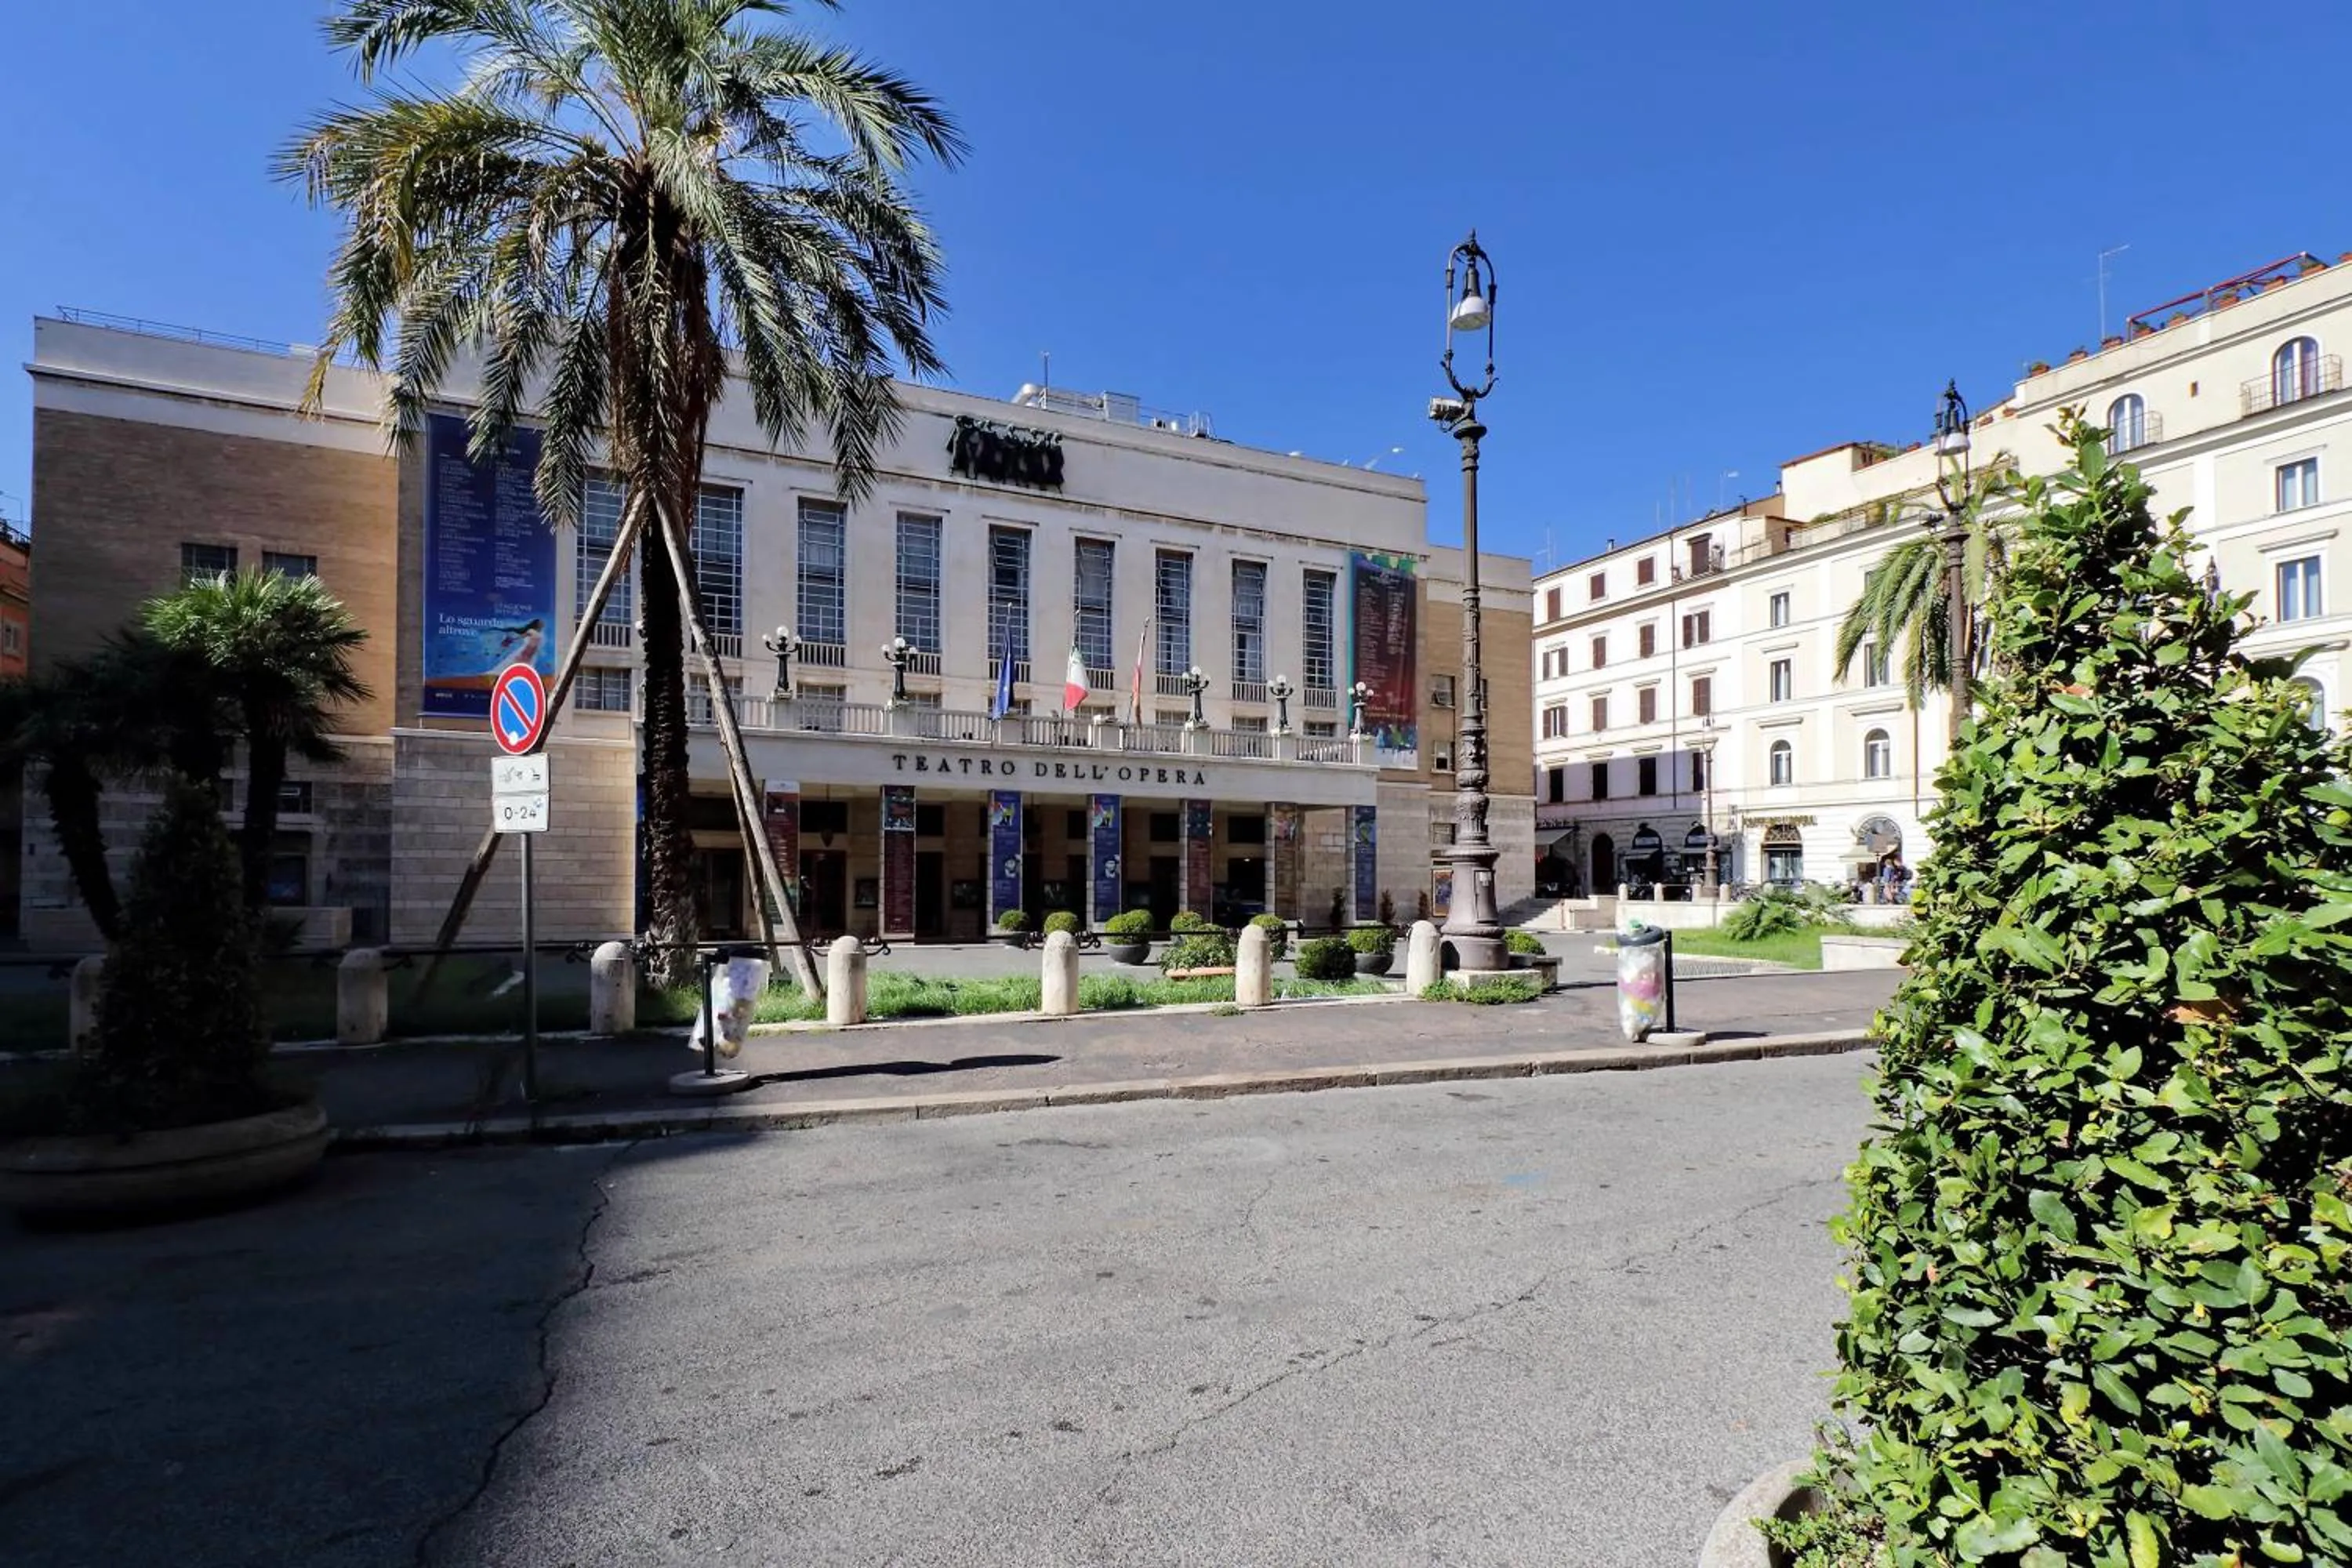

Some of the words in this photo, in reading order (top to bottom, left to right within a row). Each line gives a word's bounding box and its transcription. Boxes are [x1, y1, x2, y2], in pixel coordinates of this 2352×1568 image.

[439, 613, 454, 623] Lo
[457, 615, 503, 627] sguardo
[893, 755, 1015, 775] TEATRO
[1034, 762, 1206, 785] DELL'OPERA
[504, 806, 537, 820] 0-24
